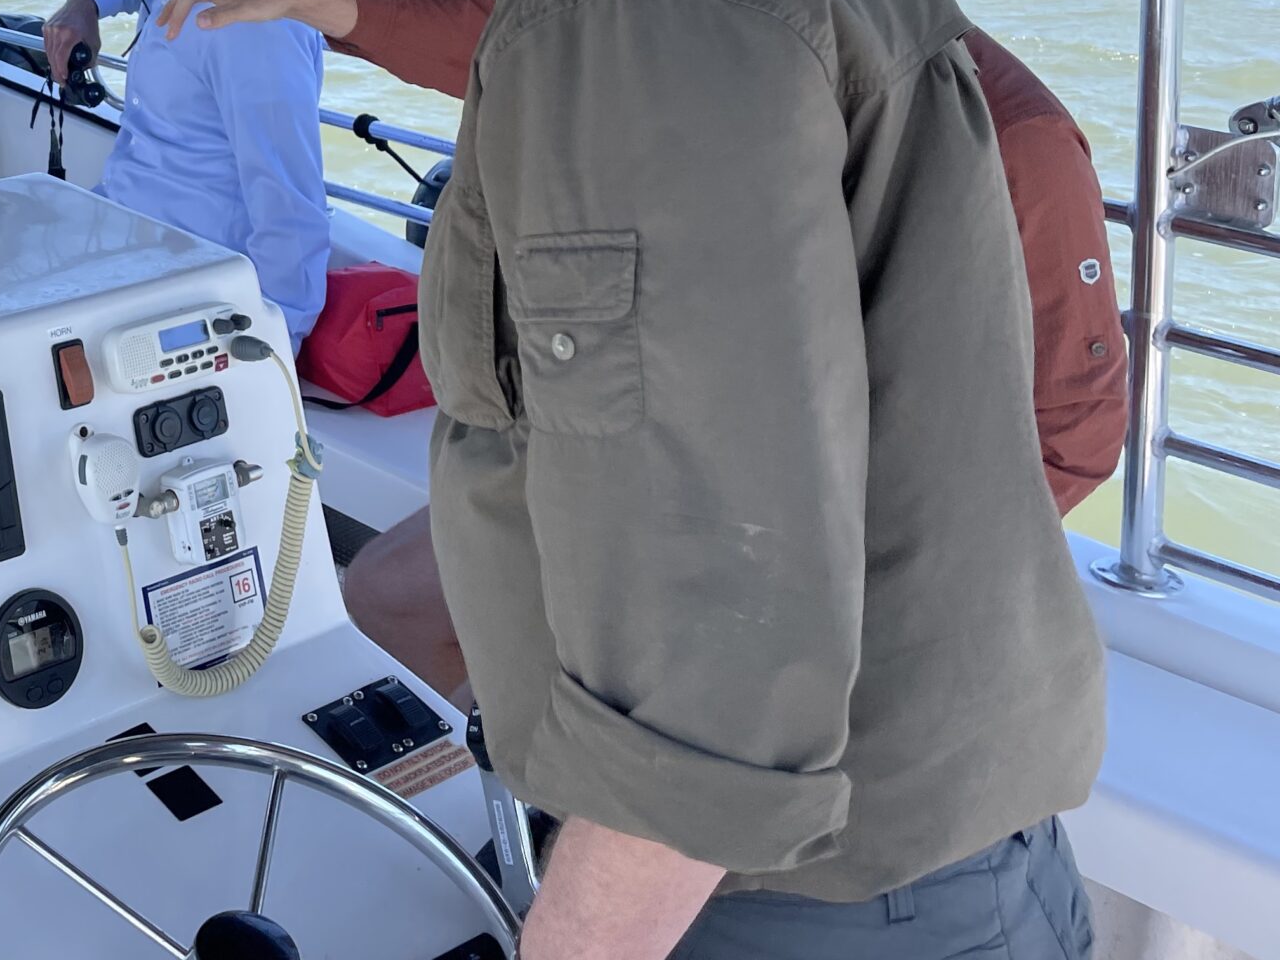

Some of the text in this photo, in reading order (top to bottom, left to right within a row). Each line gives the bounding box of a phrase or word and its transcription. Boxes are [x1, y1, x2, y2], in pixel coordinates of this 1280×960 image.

[50, 326, 72, 338] HORN
[235, 577, 251, 596] 16
[24, 609, 47, 625] YAMAHA
